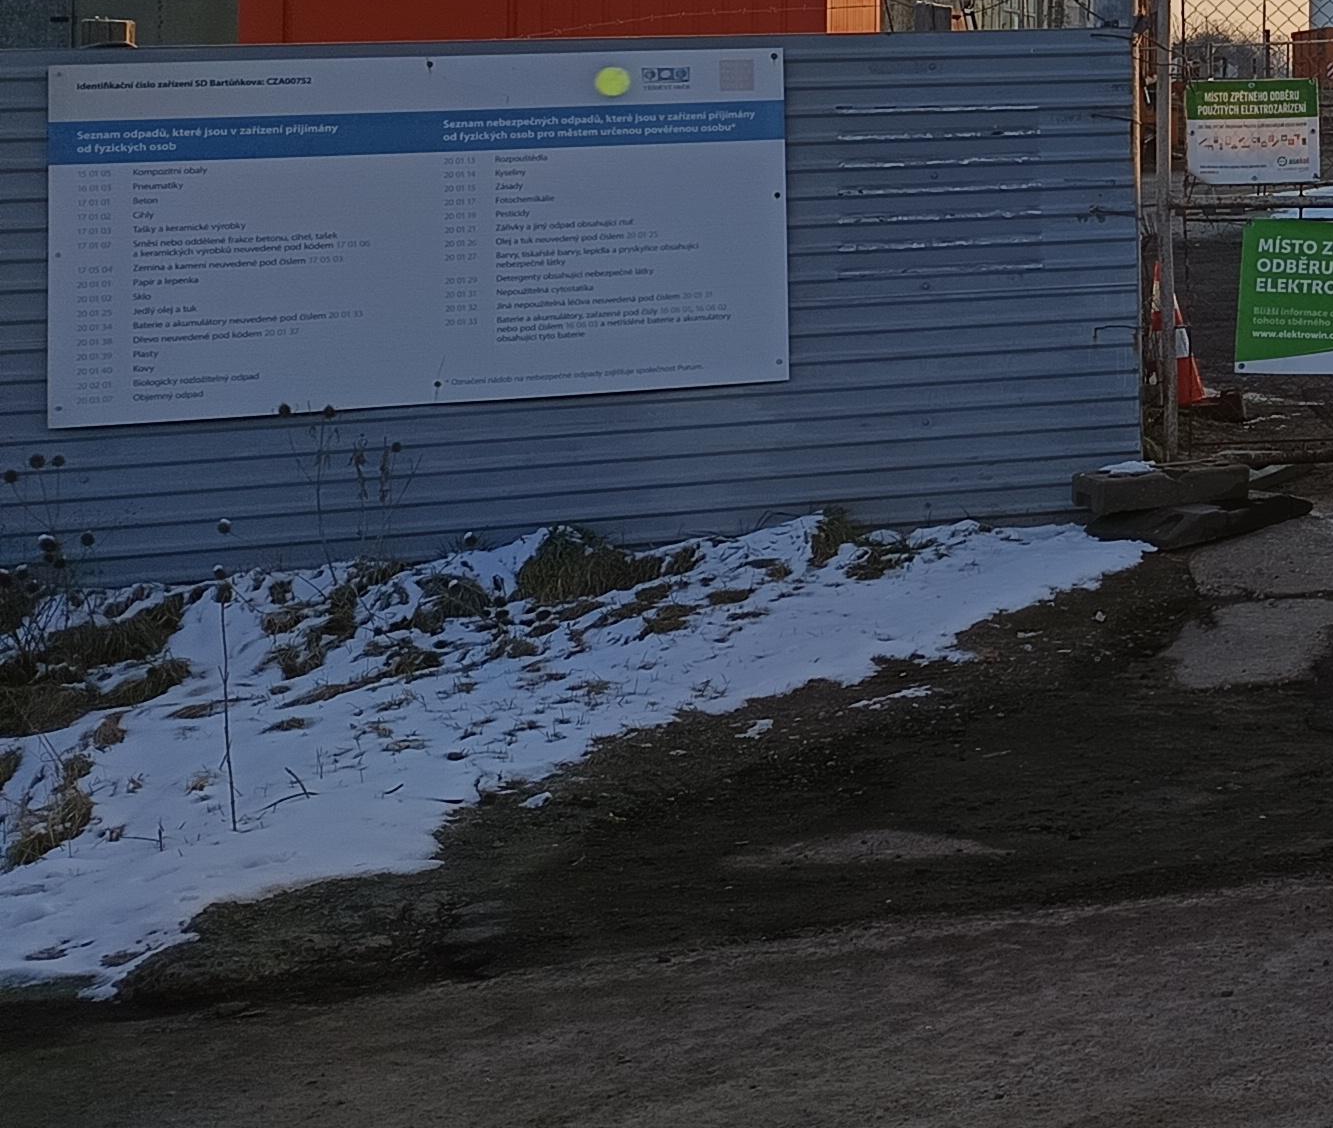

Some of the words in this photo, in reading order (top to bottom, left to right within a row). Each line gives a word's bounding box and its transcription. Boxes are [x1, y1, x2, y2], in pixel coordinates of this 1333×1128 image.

[76, 81, 133, 90] Identifikační
[135, 80, 155, 88] číslo
[157, 80, 193, 88] zařízení
[196, 80, 208, 88] SD
[266, 77, 312, 86] CZA00752
[1204, 89, 1228, 102] MÍSTO
[1230, 89, 1268, 102] ZPĚTNÉHO
[1270, 88, 1300, 100] ODBĚRU
[1198, 104, 1239, 116] POUŽITÝCH
[1241, 102, 1306, 114] ELEKTROZAŘÍZENÍ
[444, 120, 484, 128] Seznam
[486, 117, 558, 130] nebezpečných
[561, 114, 603, 127] odpadů,
[606, 113, 632, 123] které
[635, 113, 656, 125] jsou
[659, 114, 666, 122] v
[667, 111, 706, 121] zařízení
[708, 110, 756, 122] přijímány
[77, 130, 120, 140] Seznam
[123, 128, 170, 141] odpadů,
[172, 127, 202, 137] které
[204, 127, 228, 138] jsou
[230, 128, 236, 136] v
[240, 125, 283, 135] zařízení
[286, 124, 338, 136] přijímány
[444, 132, 456, 142] od
[459, 130, 508, 143] fyzických
[510, 130, 534, 140] osob
[537, 132, 554, 142] pro
[557, 128, 598, 138] městem
[600, 126, 642, 136] určenou
[644, 124, 698, 136] pověřenou
[77, 144, 92, 154] od
[95, 142, 146, 155] fyzických
[150, 142, 177, 152] osob
[184, 166, 208, 176] obaly
[133, 182, 184, 192] Pneumatiky
[1258, 236, 1318, 254] MÍSTO
[1257, 257, 1333, 274] ODBĚRU
[1254, 306, 1280, 316] Bližší
[1281, 308, 1328, 317] informace
[1253, 317, 1286, 326] tohoto
[1288, 317, 1331, 327] sběrného
[134, 350, 158, 360] Plasty
[134, 365, 154, 374] Kovy
